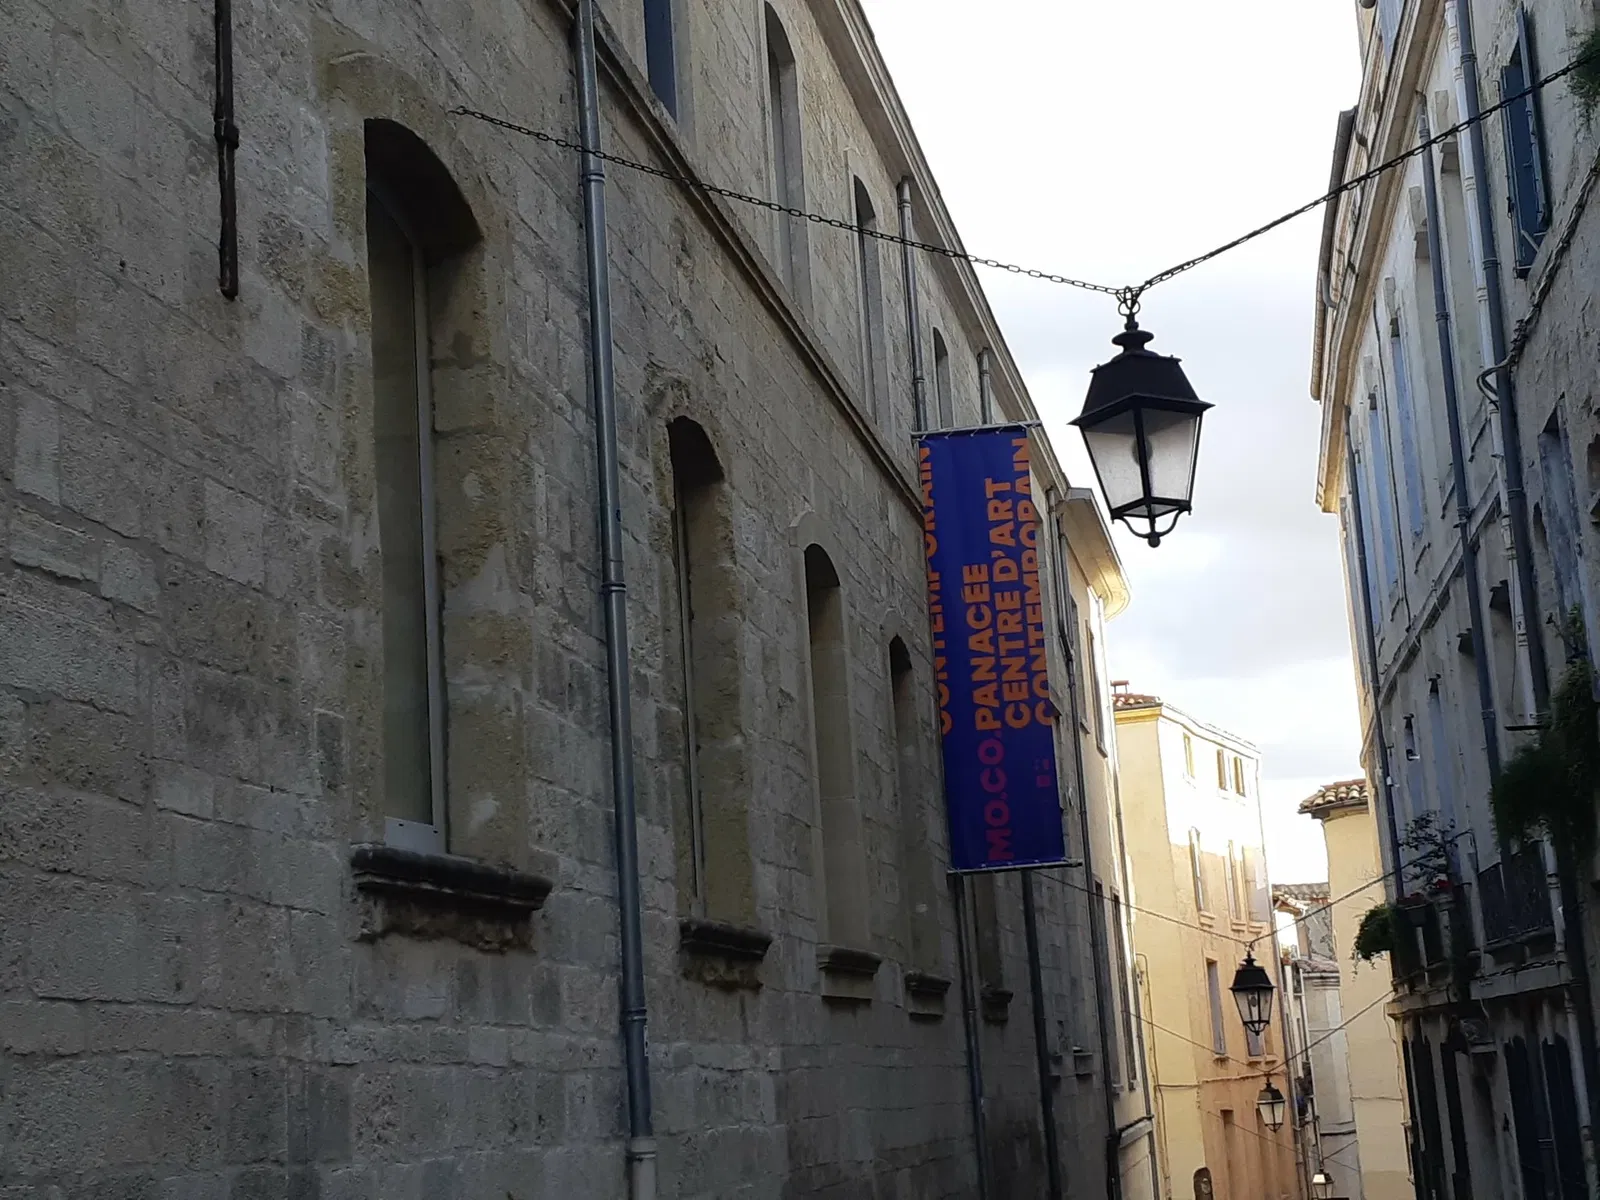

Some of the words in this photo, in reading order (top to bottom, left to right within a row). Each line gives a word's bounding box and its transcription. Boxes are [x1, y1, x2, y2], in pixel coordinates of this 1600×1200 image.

[984, 477, 1019, 582] D'ART
[961, 563, 1002, 730] PANACÉE
[995, 590, 1031, 728] CENTRE
